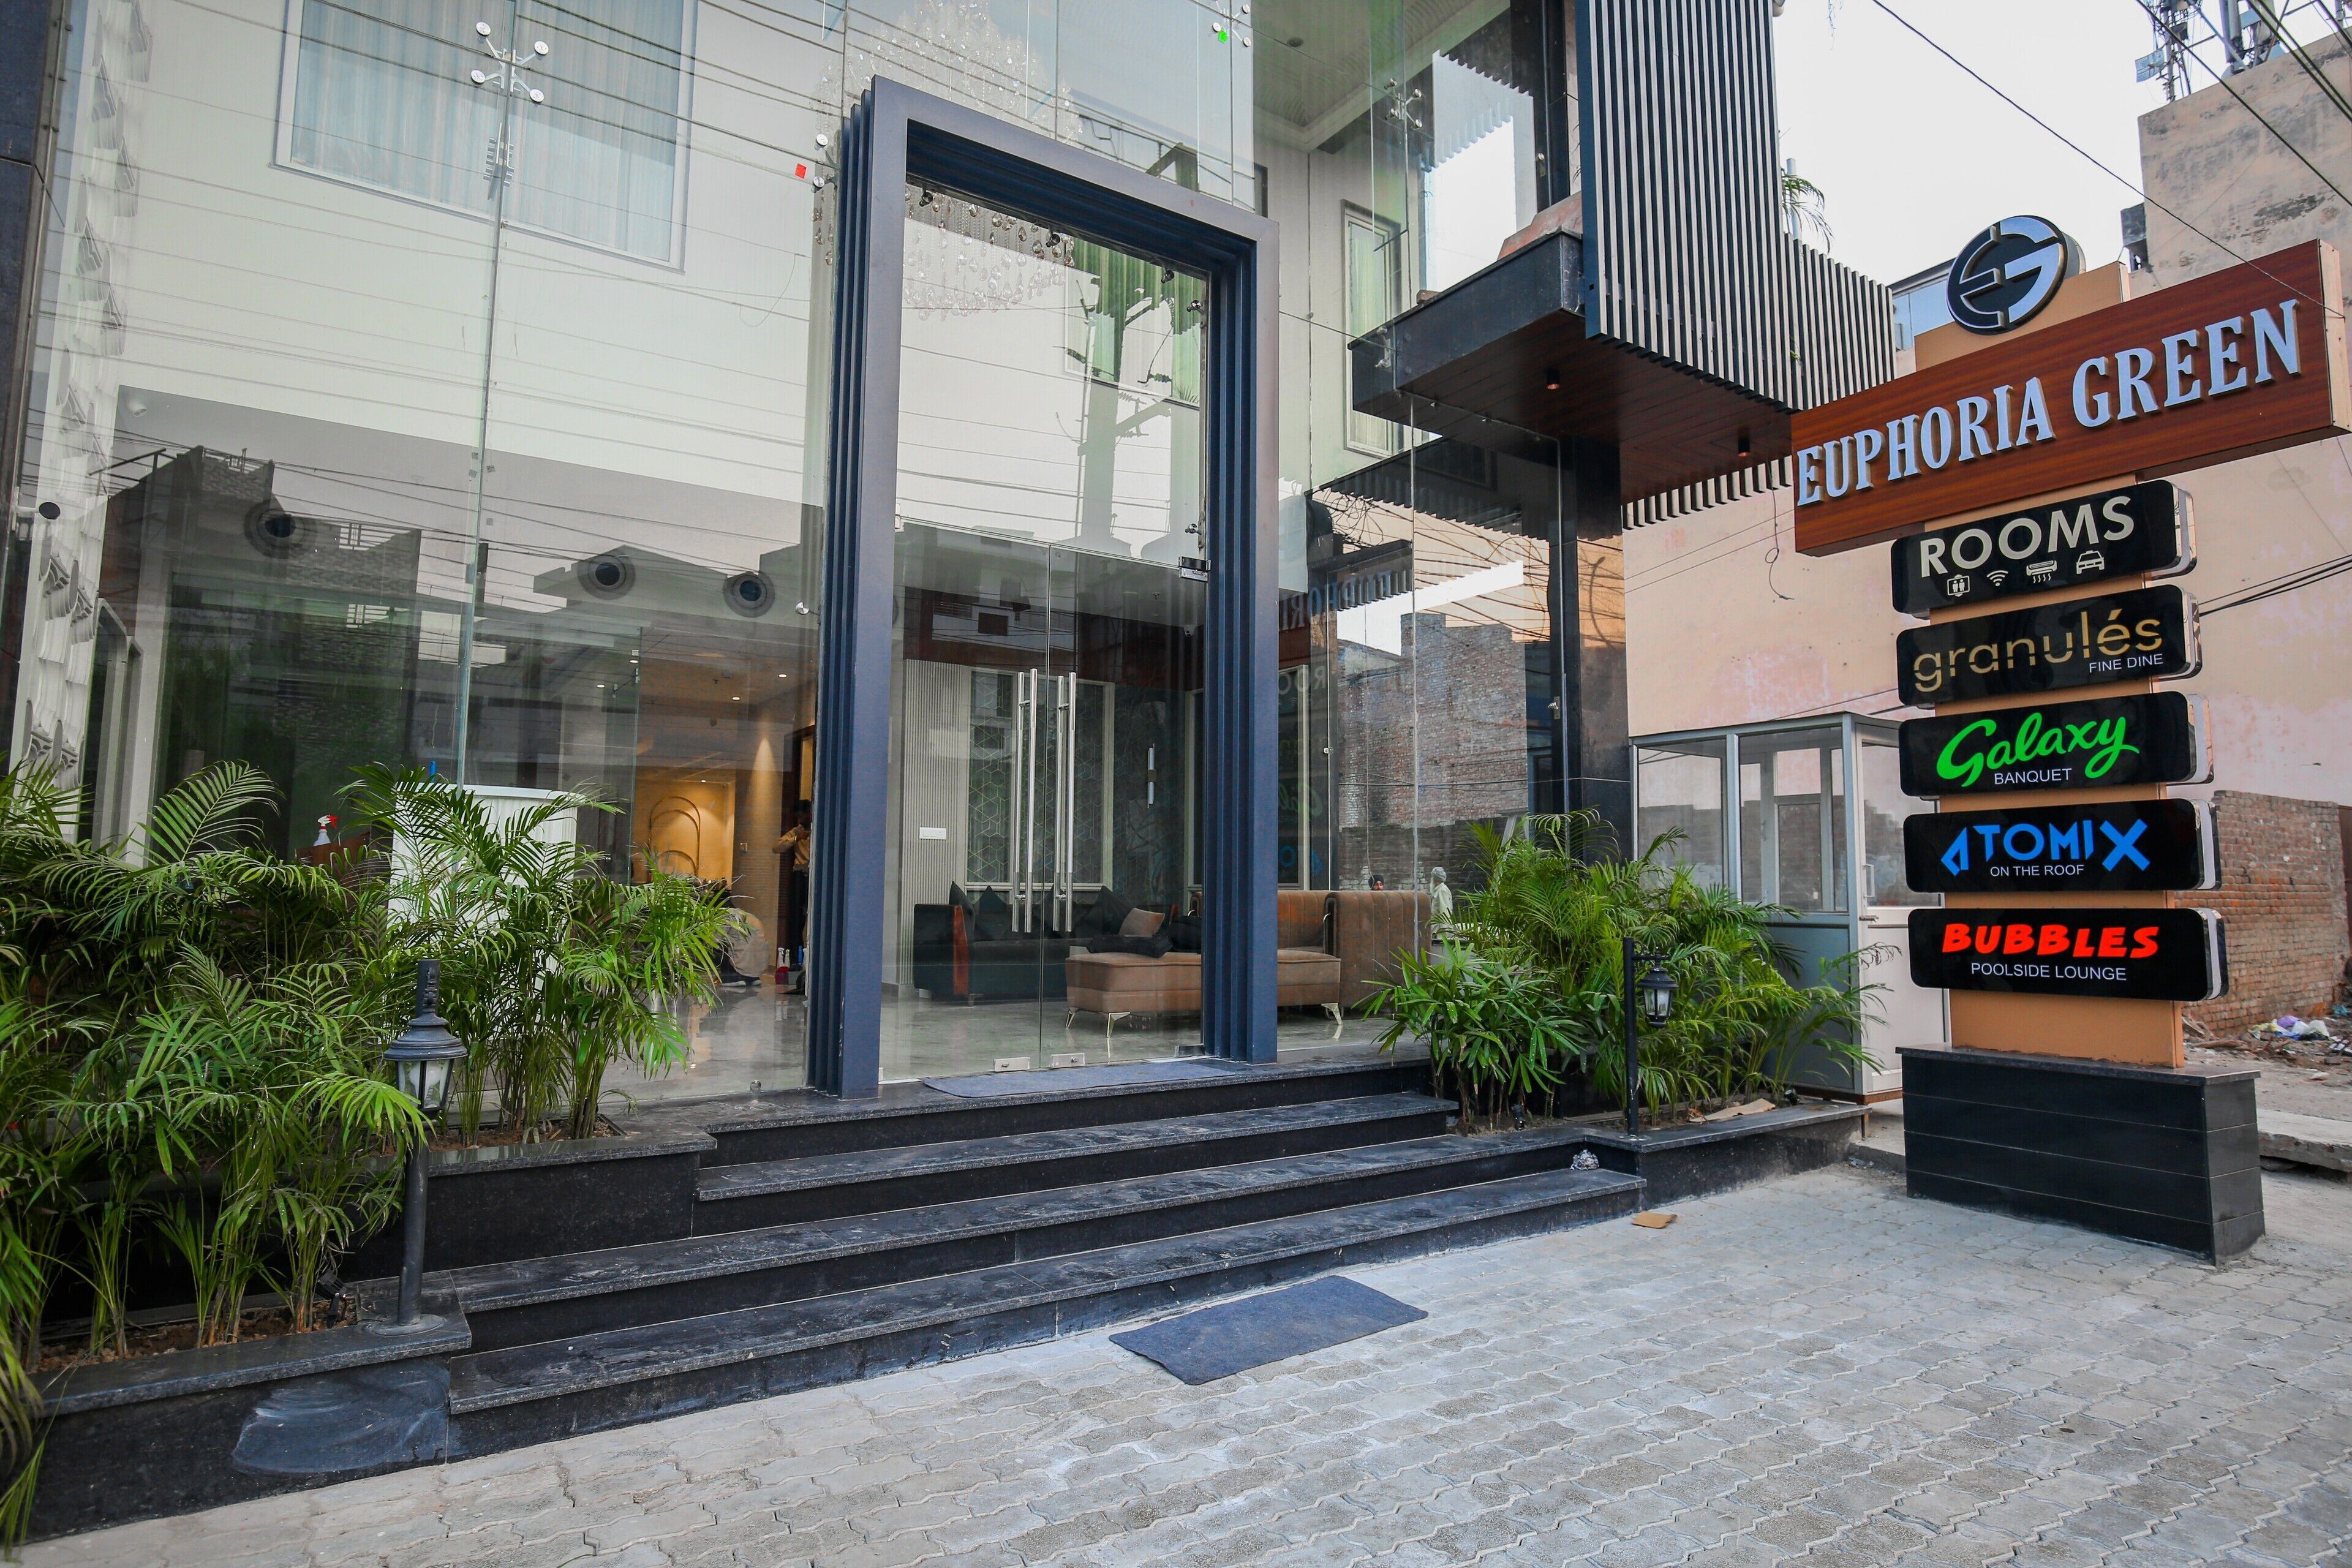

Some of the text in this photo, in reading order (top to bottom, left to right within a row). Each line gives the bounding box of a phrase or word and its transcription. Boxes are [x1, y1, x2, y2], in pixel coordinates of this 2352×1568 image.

[1796, 299, 2300, 507] EUPHORIA GREEN
[1920, 496, 2135, 578] ROOMS
[1913, 608, 2163, 692] granulés
[2089, 654, 2163, 673] FINE DINE
[1936, 712, 2139, 787] Galaxy
[1994, 768, 2072, 785] BANQUET
[1990, 864, 2084, 876] ON THE ROOF
[1942, 923, 2158, 958] BUBBLES
[1971, 962, 2127, 981] POOLSIDE LOUNGE
